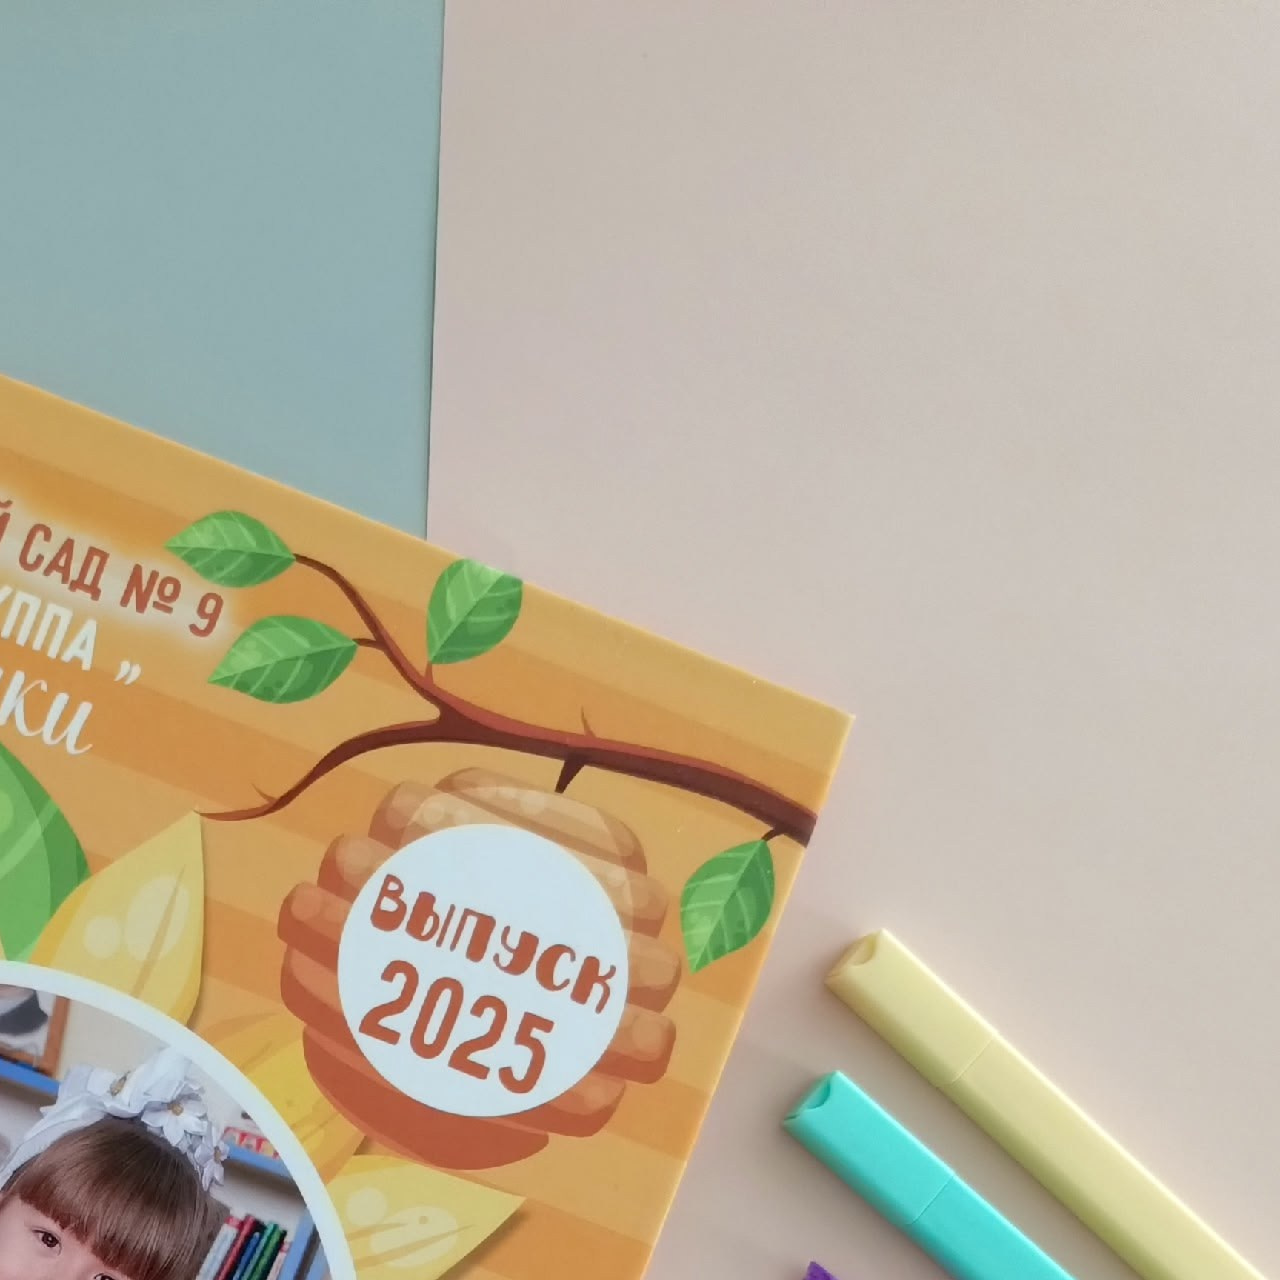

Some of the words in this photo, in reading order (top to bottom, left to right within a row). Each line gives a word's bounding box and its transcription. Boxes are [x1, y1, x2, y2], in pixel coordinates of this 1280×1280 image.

[19, 523, 110, 601] САД
[120, 564, 181, 614] №
[189, 592, 224, 637] 9
[370, 873, 617, 1014] ВЫПУСК
[358, 959, 555, 1094] 2025
